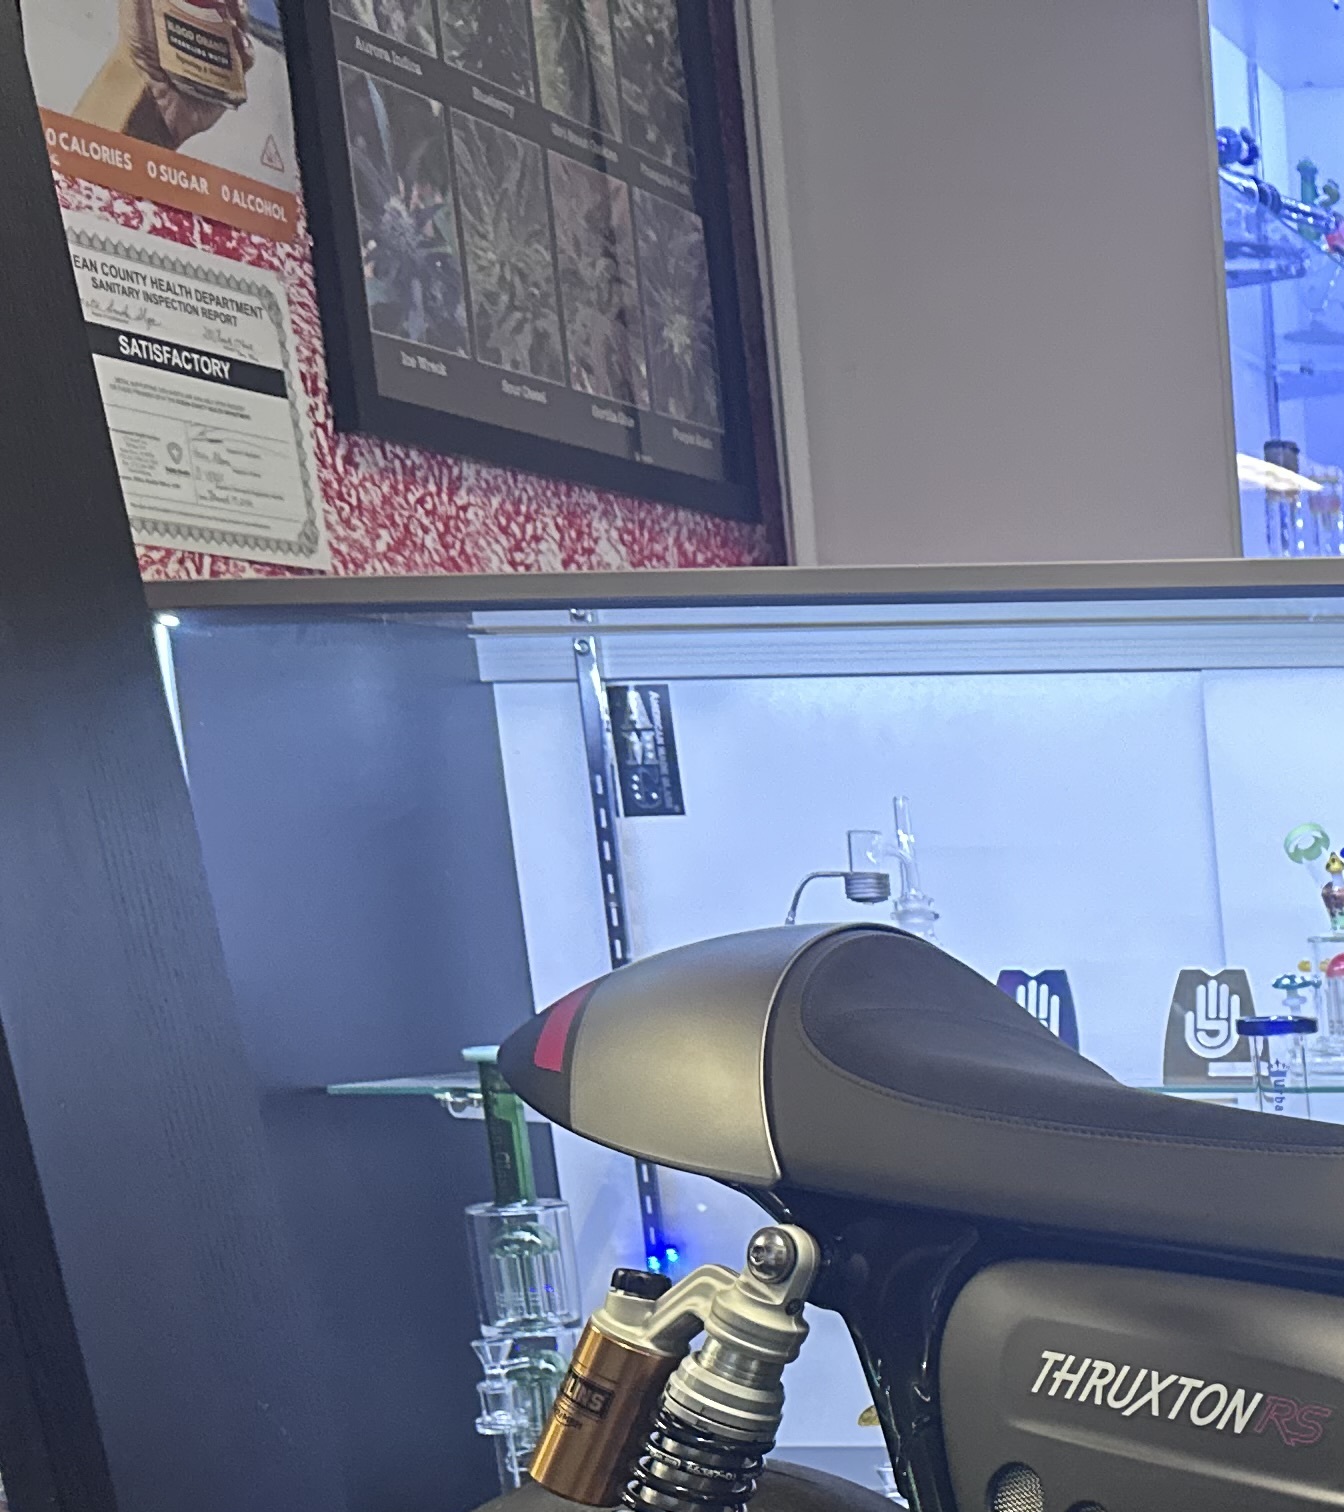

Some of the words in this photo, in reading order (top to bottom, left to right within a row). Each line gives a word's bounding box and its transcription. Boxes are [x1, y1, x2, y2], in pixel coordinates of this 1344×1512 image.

[45, 127, 57, 146] 0
[58, 131, 133, 171] CALORIES
[146, 160, 157, 178] 0
[159, 163, 210, 195] SUGAR
[221, 184, 229, 202] 0
[231, 187, 288, 223] ALCOHOL
[73, 254, 99, 274] EAN
[101, 261, 148, 287] COUNTY
[149, 274, 193, 300] HEALTH
[193, 288, 265, 320] DEPARTMENT
[91, 276, 141, 300] SANITARY
[142, 290, 200, 317] INSPECTION
[200, 307, 238, 328] REPORT
[118, 334, 231, 380] SATISFACTORY
[1031, 1350, 1263, 1434] THRUXTON
[1253, 1396, 1332, 1446] RS
